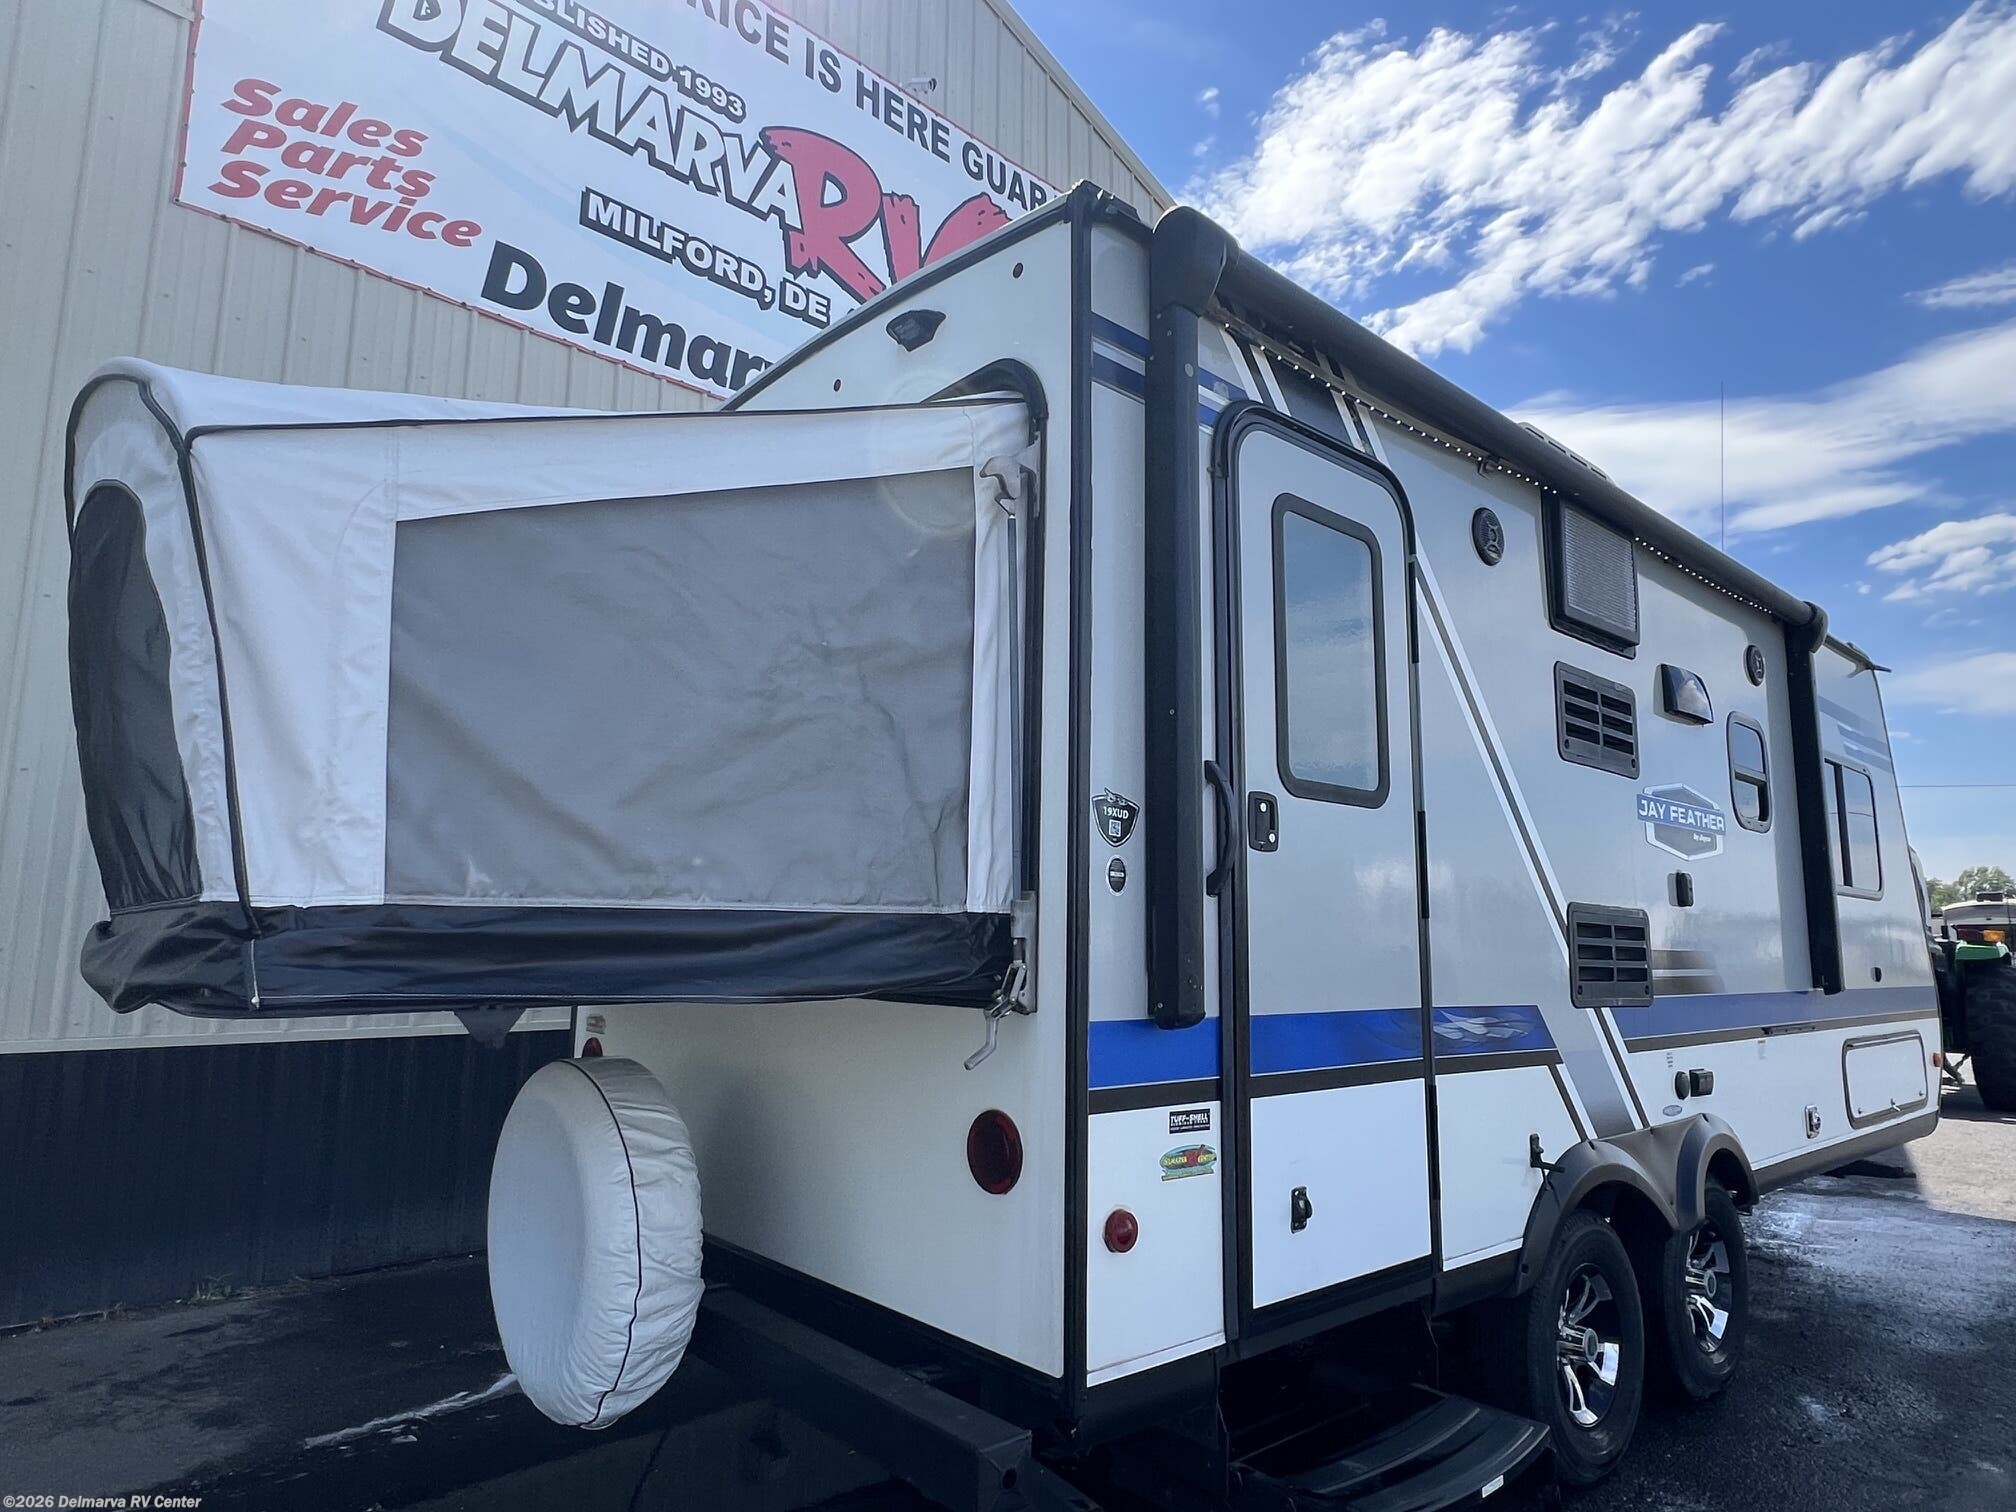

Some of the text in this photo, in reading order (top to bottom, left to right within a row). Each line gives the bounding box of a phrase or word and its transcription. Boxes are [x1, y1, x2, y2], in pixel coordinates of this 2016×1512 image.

[220, 78, 429, 158] Sales
[376, 0, 803, 230] DELMARVA
[675, 67, 746, 121] 1993
[804, 37, 842, 94] IS
[856, 68, 951, 164] HERE
[961, 140, 1057, 212] GUAR
[220, 118, 437, 199] Parts
[207, 160, 483, 248] Service
[582, 188, 830, 327] MILFORD, DE
[480, 240, 775, 392] Delmar
[1103, 806, 1129, 819] 19XUD
[1638, 799, 1725, 832] JAY FEATHER
